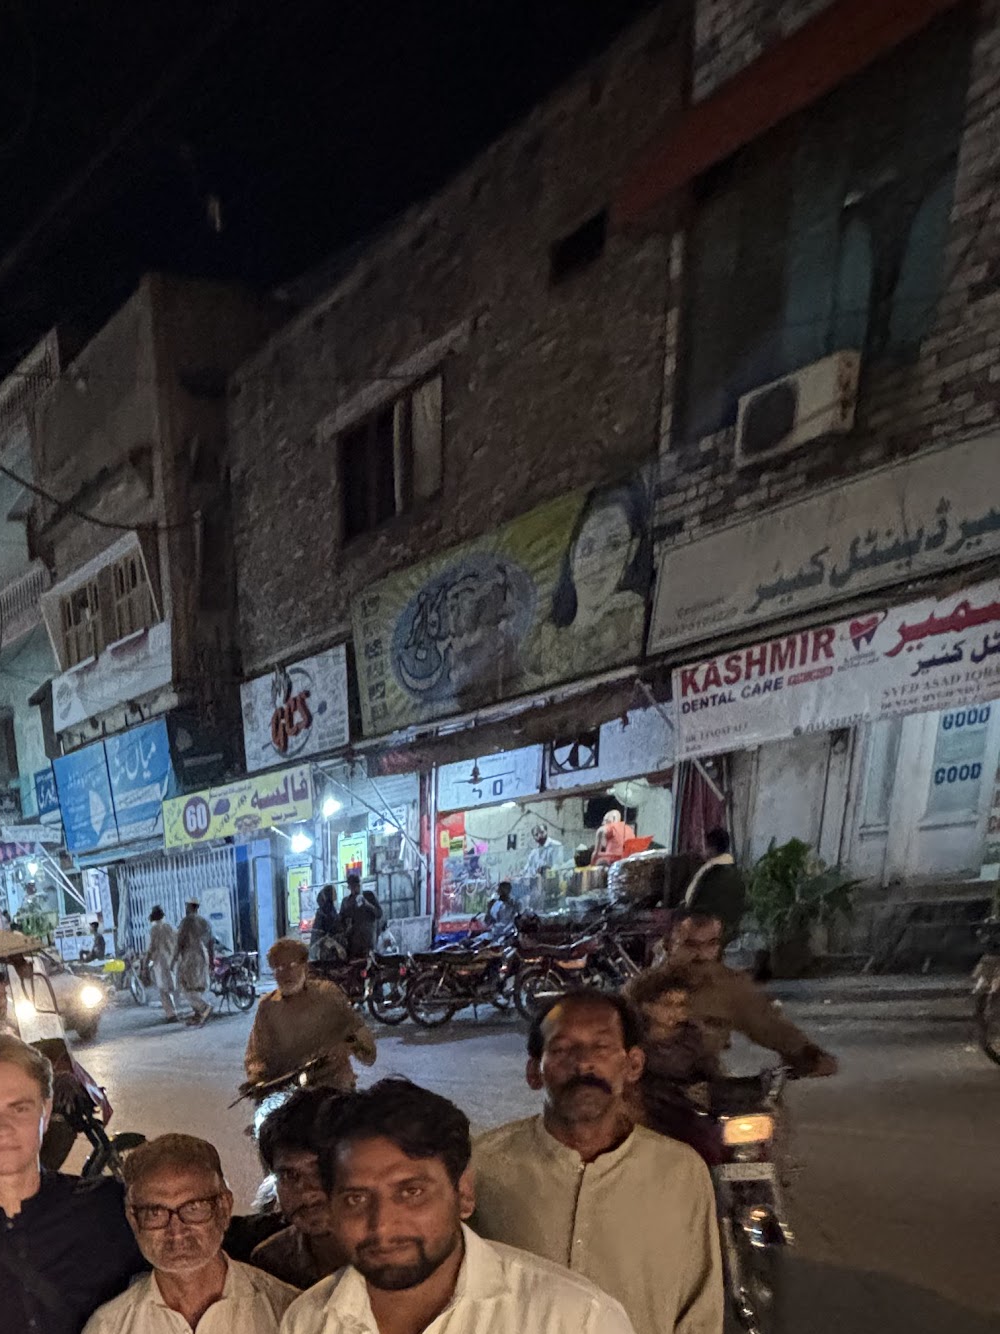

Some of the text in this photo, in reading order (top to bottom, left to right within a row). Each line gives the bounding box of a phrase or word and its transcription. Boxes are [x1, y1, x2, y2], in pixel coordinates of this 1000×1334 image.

[681, 627, 836, 697] KASHMIR
[682, 677, 785, 714] DENTAL CARE
[942, 706, 991, 731] GOOD
[935, 762, 983, 785] GOOD
[185, 804, 208, 833] 60
